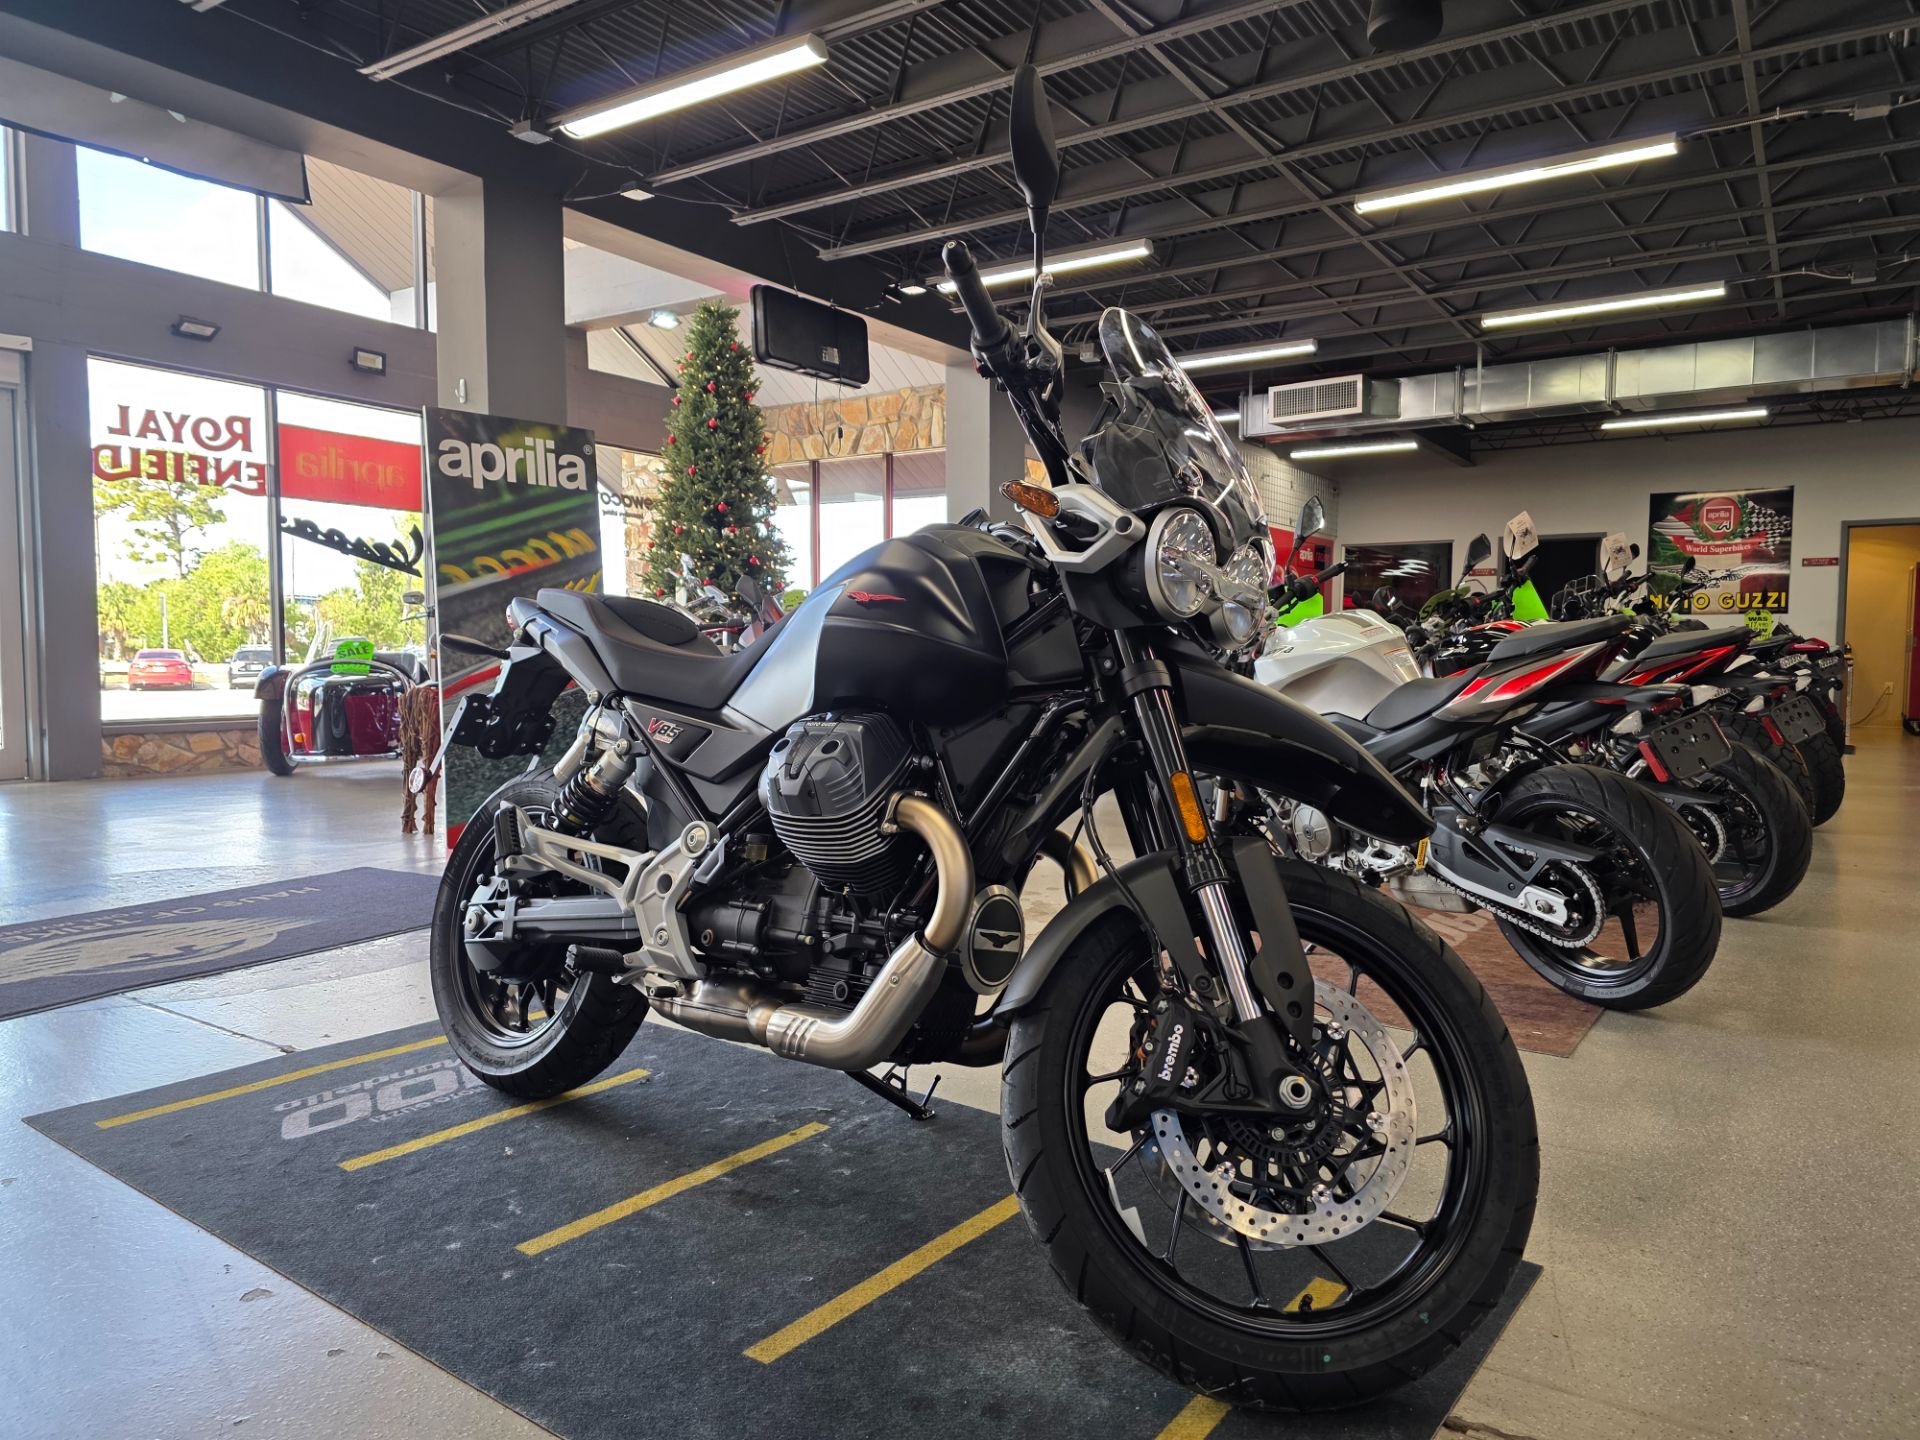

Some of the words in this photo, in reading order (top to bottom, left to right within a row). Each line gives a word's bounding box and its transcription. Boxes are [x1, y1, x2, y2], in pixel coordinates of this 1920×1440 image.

[438, 436, 588, 490] aprilia
[1685, 544, 1708, 553] World
[1709, 544, 1751, 554] Superbikes
[1719, 592, 1787, 609] GUZZI
[336, 644, 369, 658] SALE
[212, 885, 321, 909] HAUS
[151, 905, 206, 922] OF
[1158, 1024, 1184, 1081] brembo
